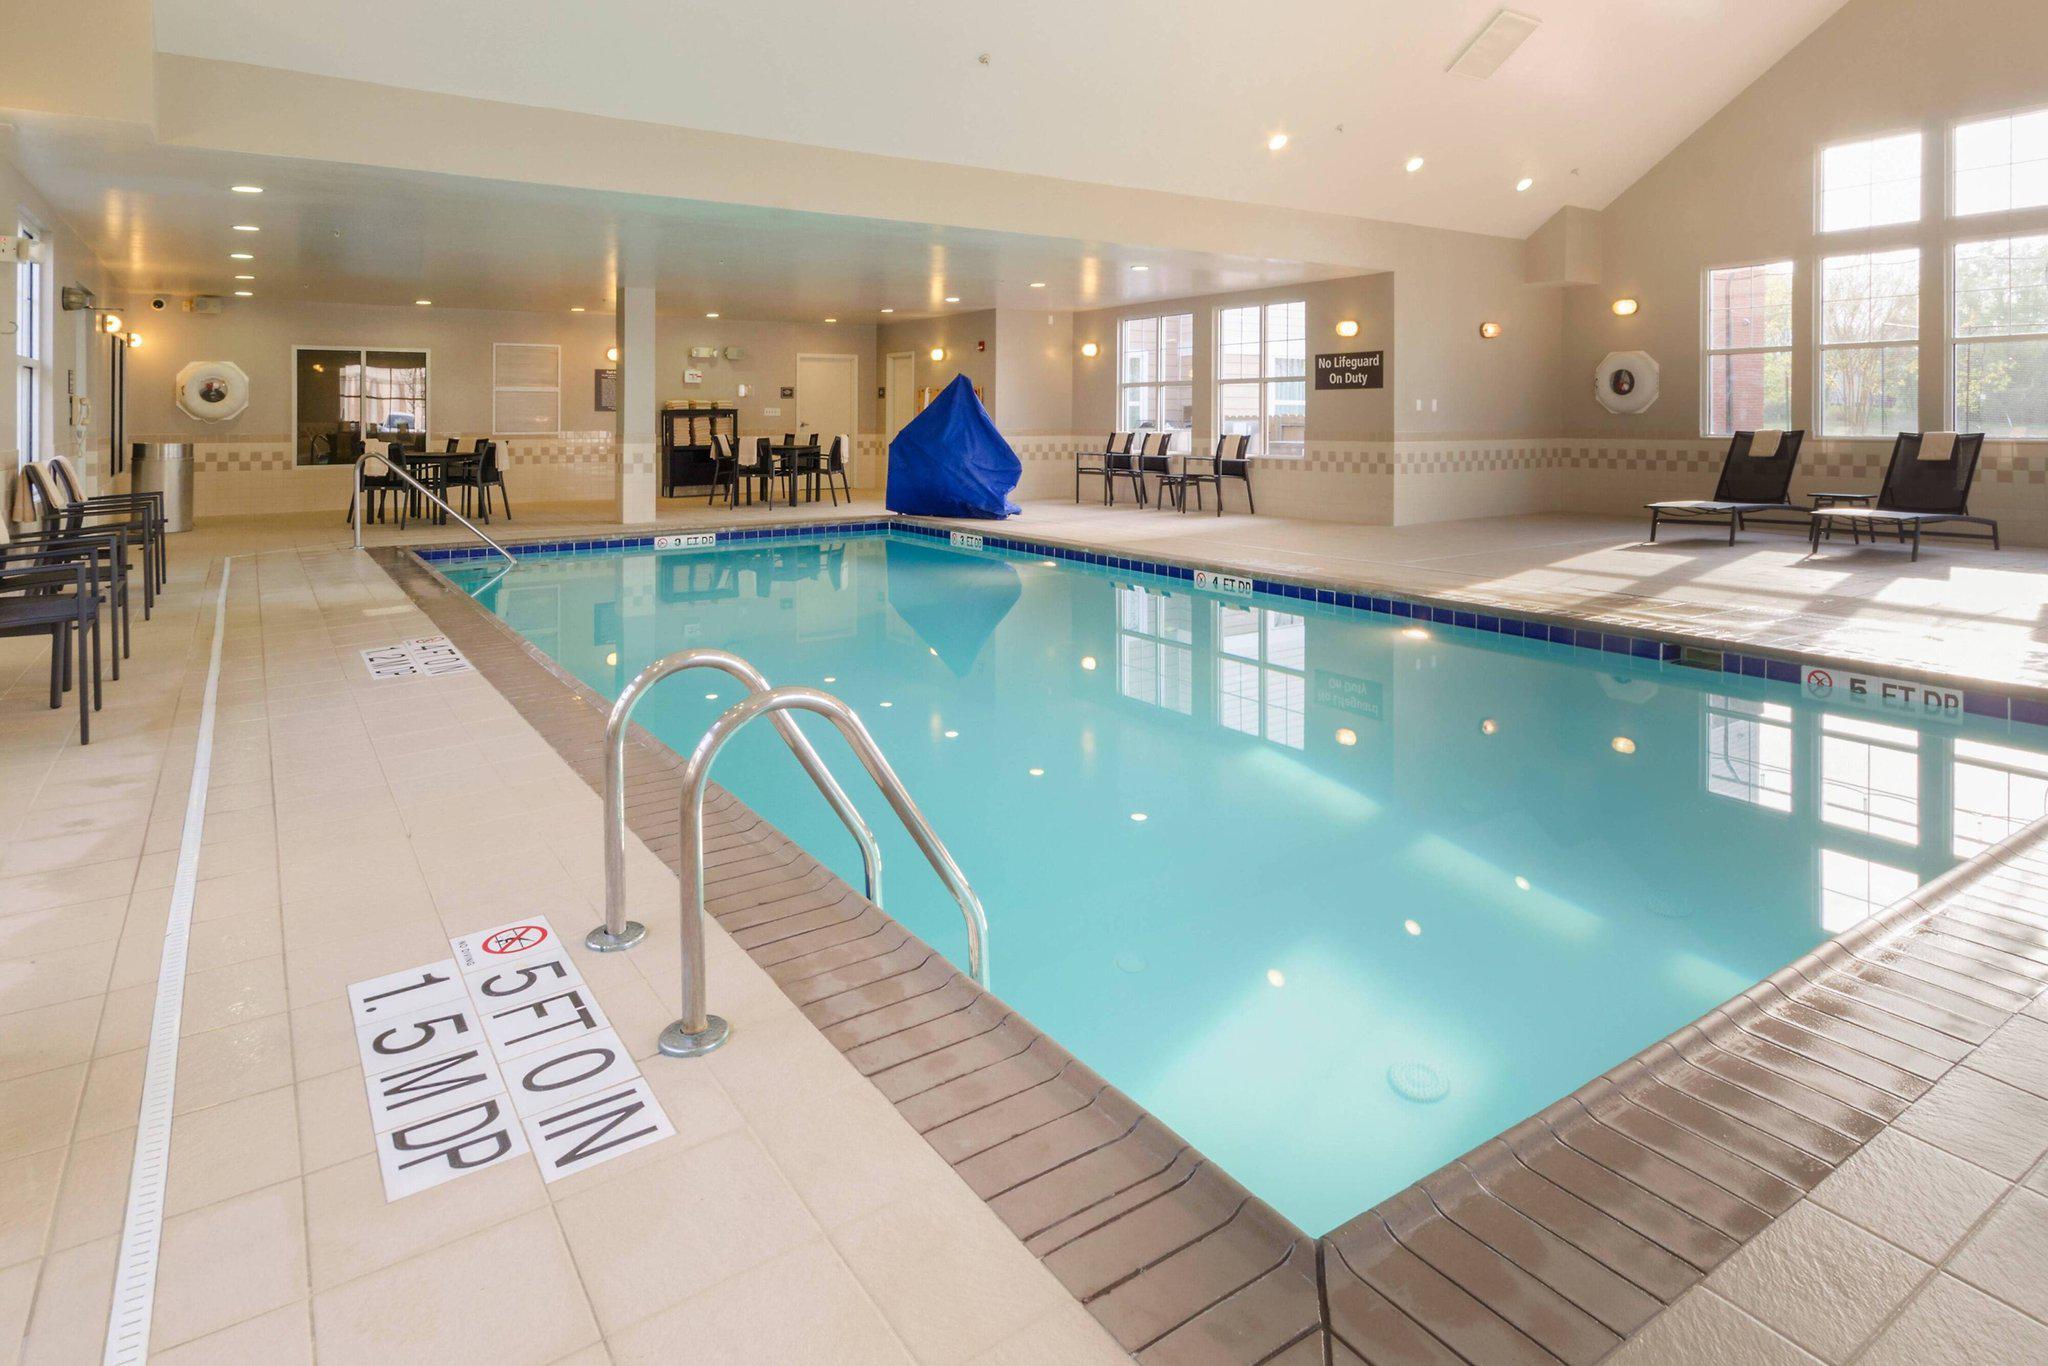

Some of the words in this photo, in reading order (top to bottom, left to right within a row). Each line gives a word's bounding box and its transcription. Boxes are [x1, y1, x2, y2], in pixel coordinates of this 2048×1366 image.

[1318, 358, 1331, 369] No
[1334, 354, 1379, 370] Lifeguard
[1329, 373, 1342, 384] On
[1345, 372, 1368, 386] Duty
[1850, 677, 1867, 695] 5
[1882, 682, 1915, 702] FT
